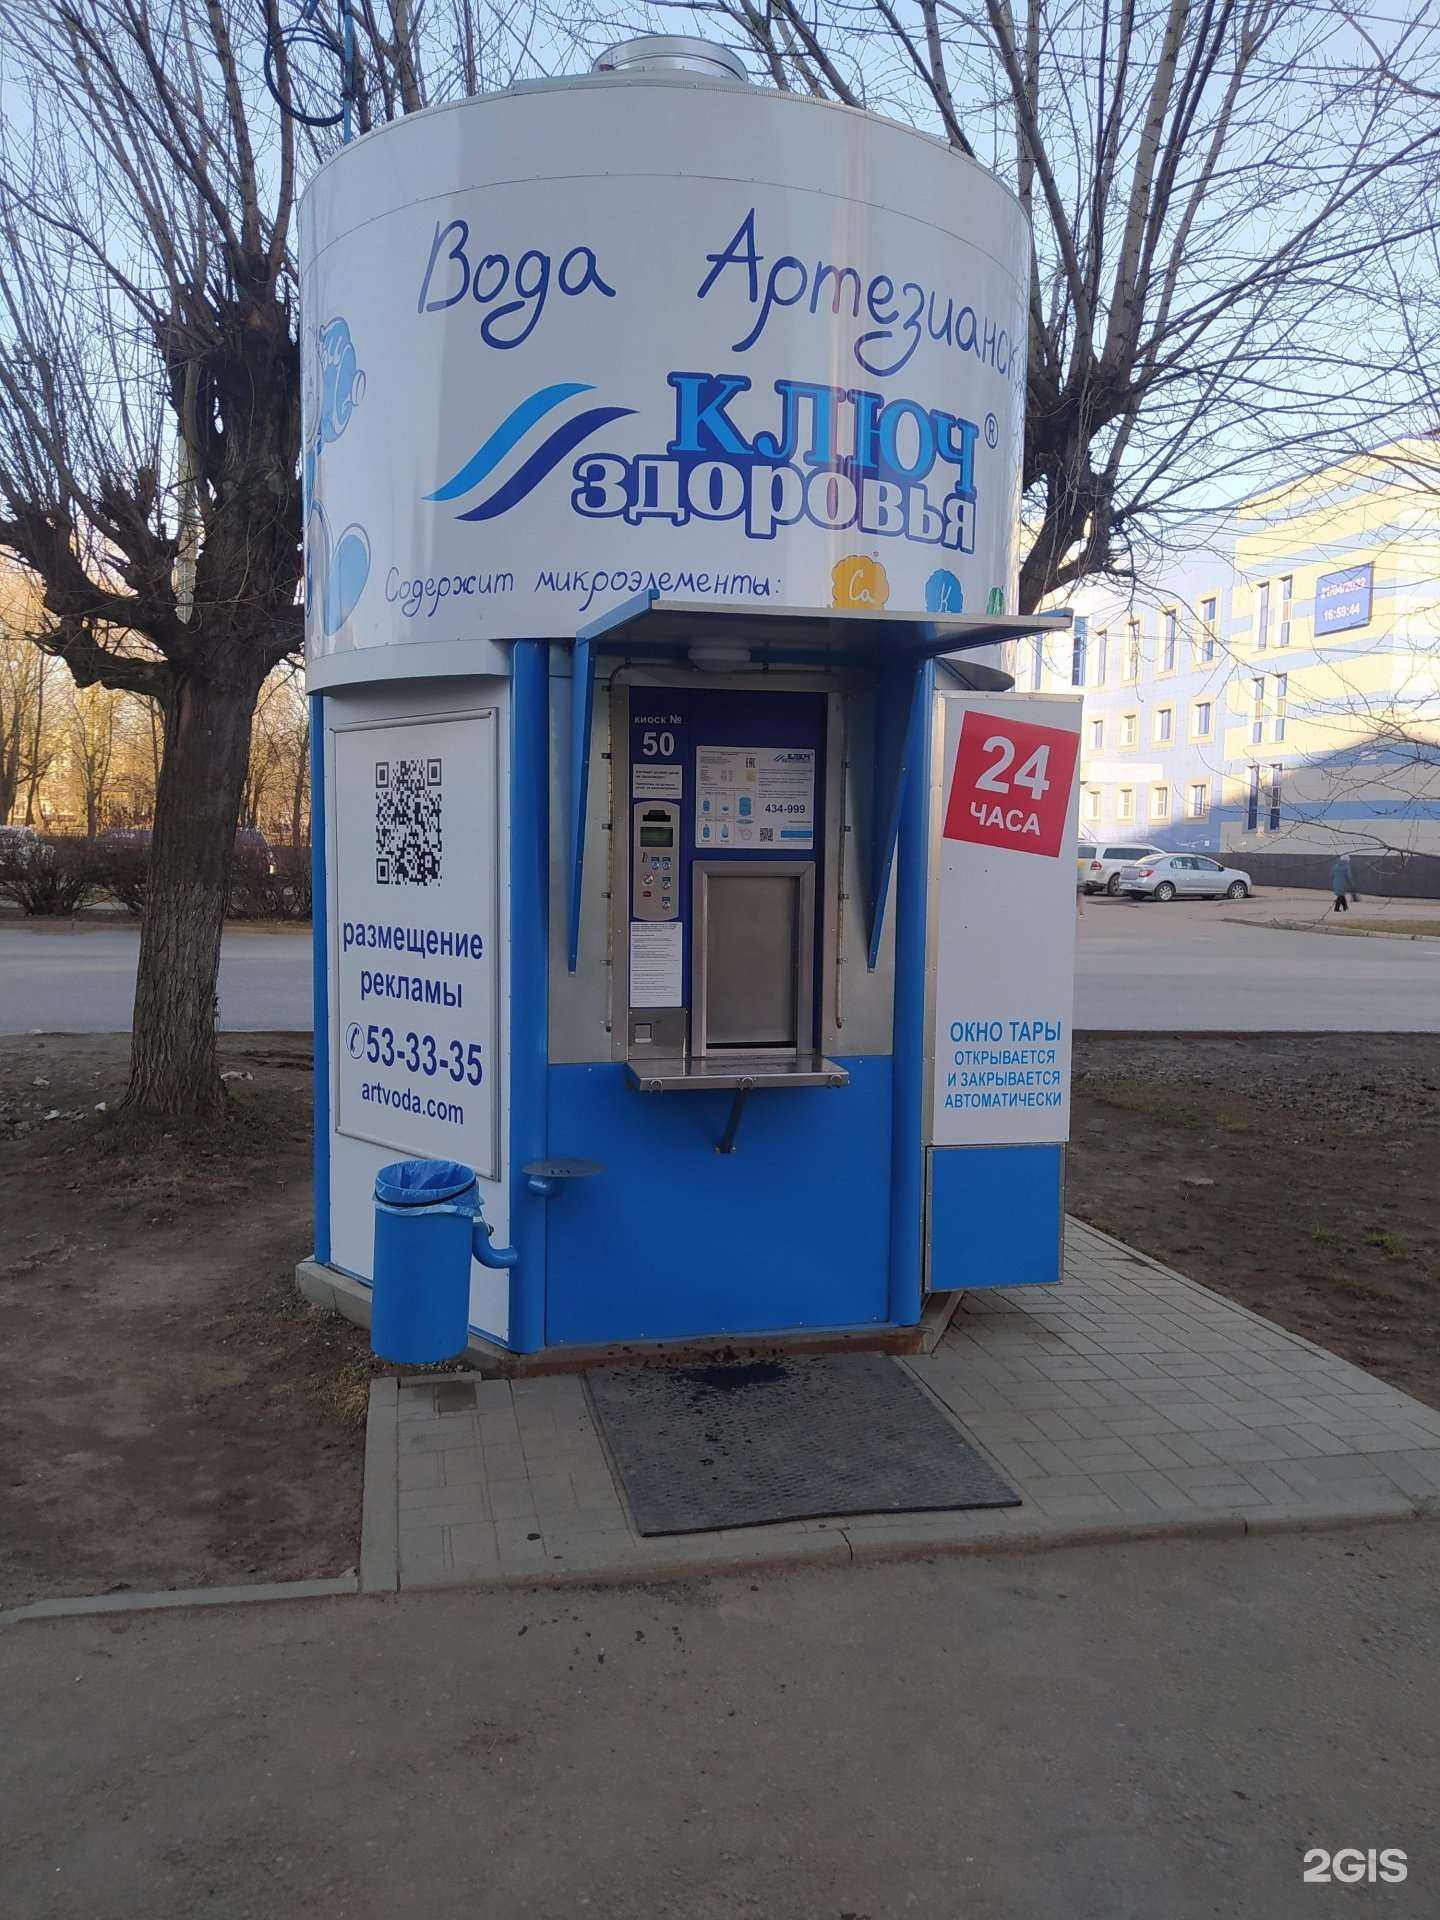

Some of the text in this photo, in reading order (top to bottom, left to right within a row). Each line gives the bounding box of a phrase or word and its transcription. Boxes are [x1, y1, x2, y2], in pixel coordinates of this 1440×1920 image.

[418, 219, 616, 350] Вода
[667, 372, 979, 499] КЛЮЧ
[385, 566, 782, 618] Содержит микроэлементы:
[642, 731, 675, 756] 50
[975, 735, 1051, 801] 24
[765, 803, 806, 814] 434-999
[969, 801, 1041, 836] ЧАСА
[343, 919, 484, 960] размещение
[360, 969, 463, 1009] рекламы
[950, 1020, 1062, 1042] ОКНО ТАРЫ
[366, 1024, 483, 1086] 53-33-35
[954, 1050, 1056, 1066] ОТКРЫВАЕТСЯ
[947, 1071, 1060, 1087] И ЗАКРЫВАЕТСЯ
[361, 1080, 464, 1126] artvoda.com
[944, 1092, 1062, 1108] АВТОМАТИЧЕСКИ
